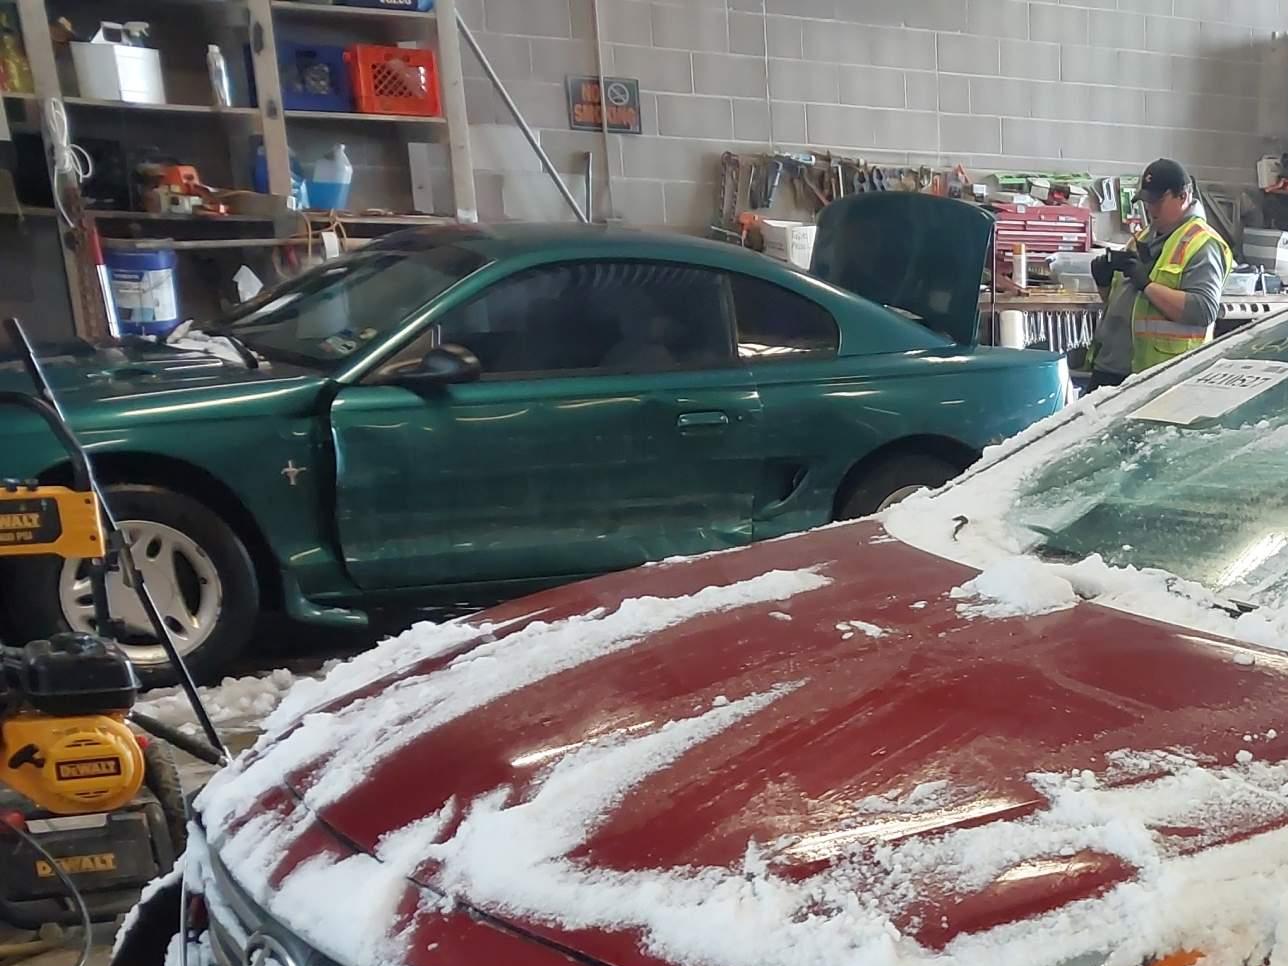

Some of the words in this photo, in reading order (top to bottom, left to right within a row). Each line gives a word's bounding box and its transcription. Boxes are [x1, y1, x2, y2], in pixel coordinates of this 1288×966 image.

[581, 82, 600, 102] NO
[0, 513, 41, 529] WALT
[60, 760, 117, 778] DEWALT
